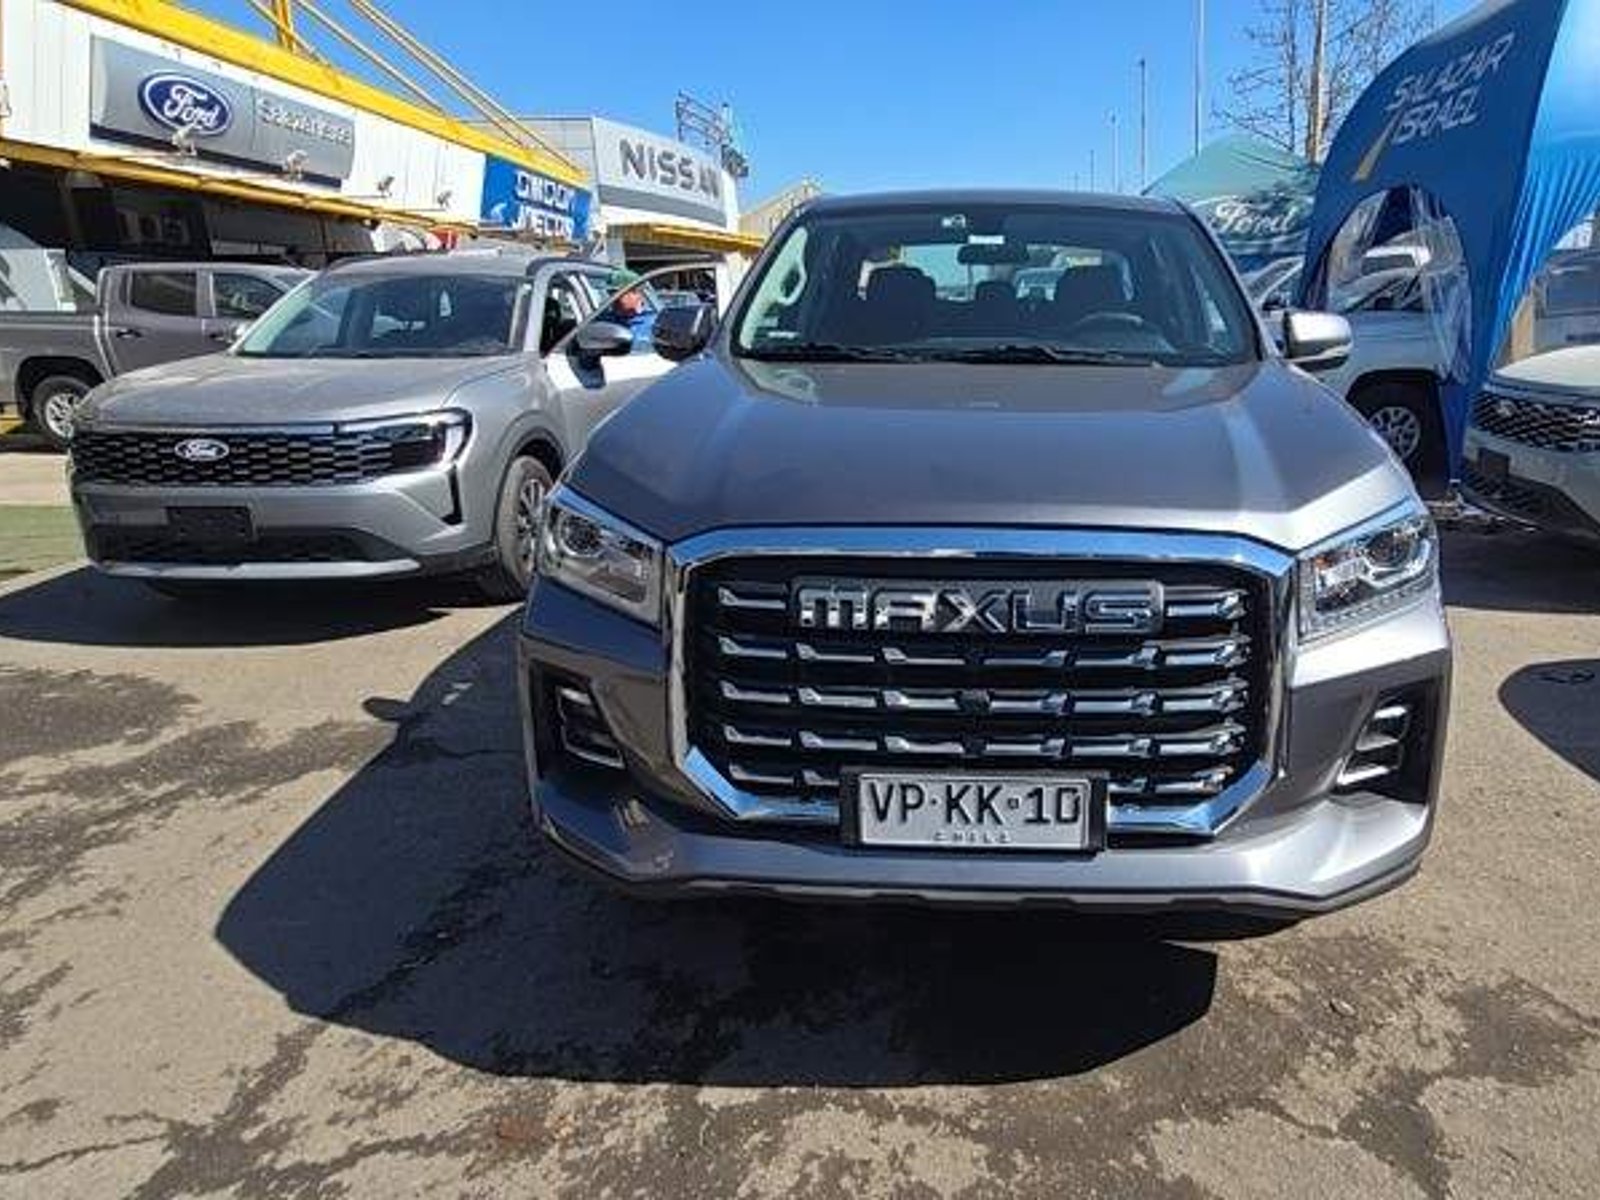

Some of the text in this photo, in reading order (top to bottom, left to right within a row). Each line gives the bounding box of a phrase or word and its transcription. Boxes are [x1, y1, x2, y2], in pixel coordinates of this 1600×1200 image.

[160, 83, 222, 131] Ford
[1215, 200, 1302, 236] Ford
[799, 584, 1153, 634] MAXUS
